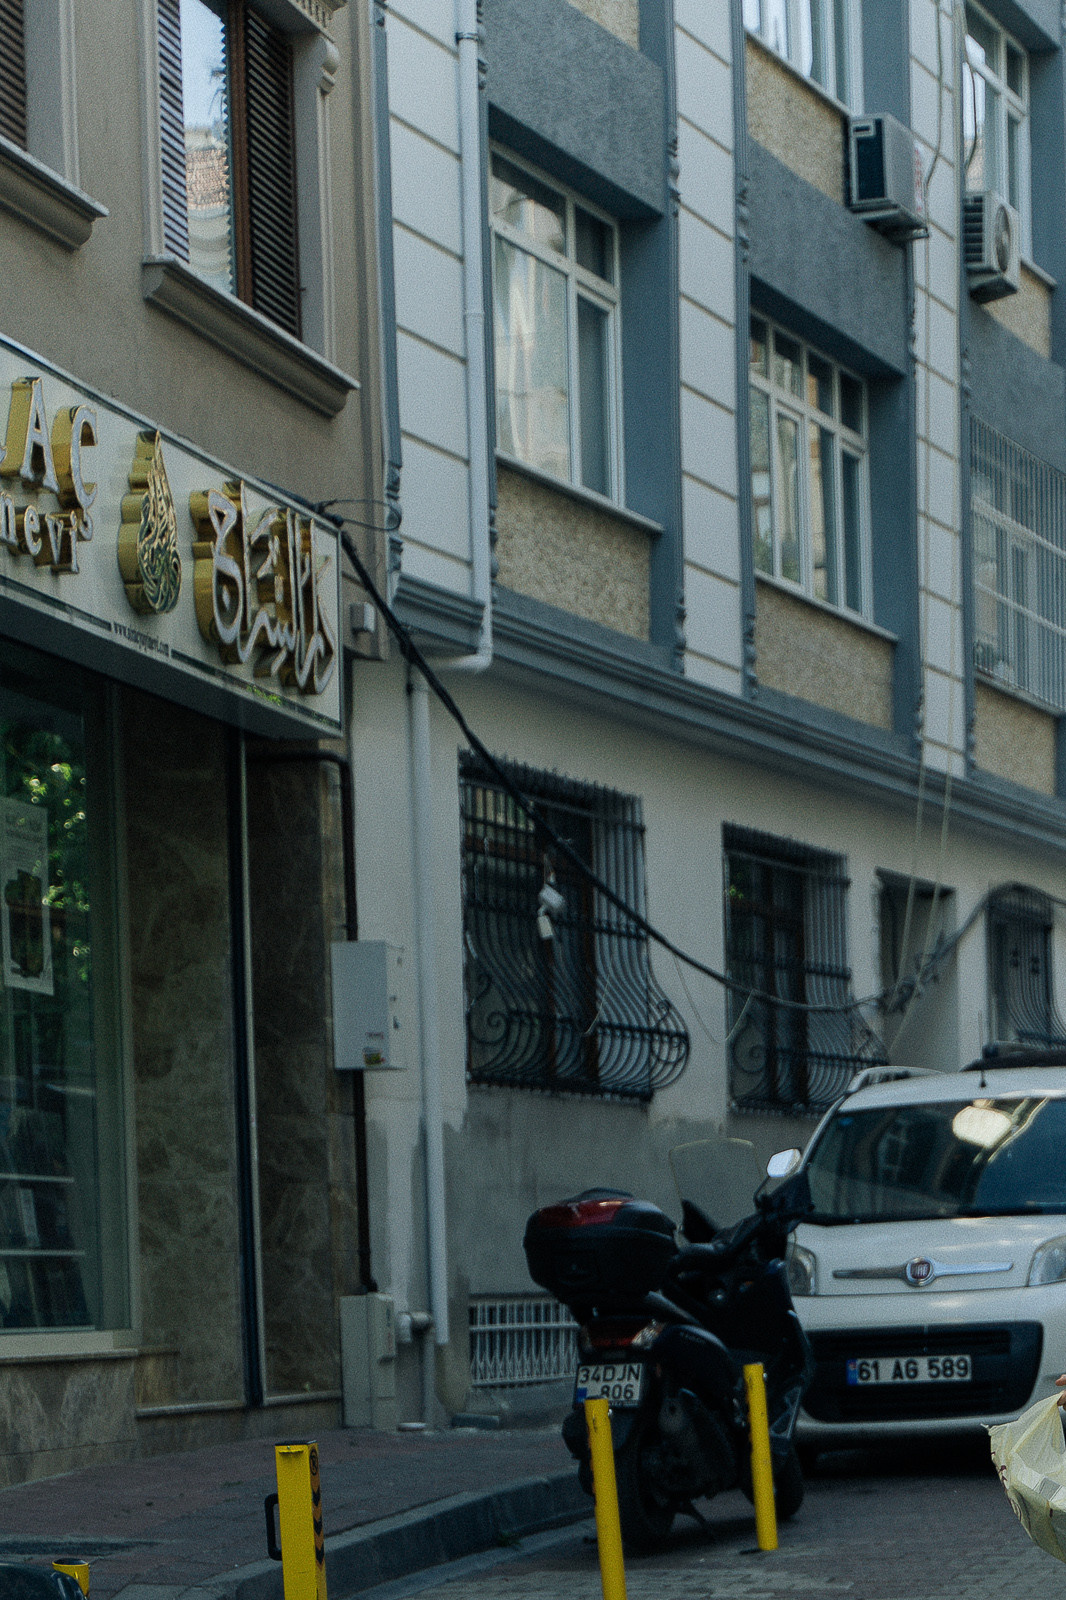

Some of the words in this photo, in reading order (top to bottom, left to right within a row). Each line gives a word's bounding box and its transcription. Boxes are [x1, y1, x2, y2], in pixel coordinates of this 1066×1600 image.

[0, 377, 98, 541] AÇ
[858, 1360, 879, 1381] 61
[892, 1359, 918, 1380] AG
[927, 1356, 969, 1379] 589
